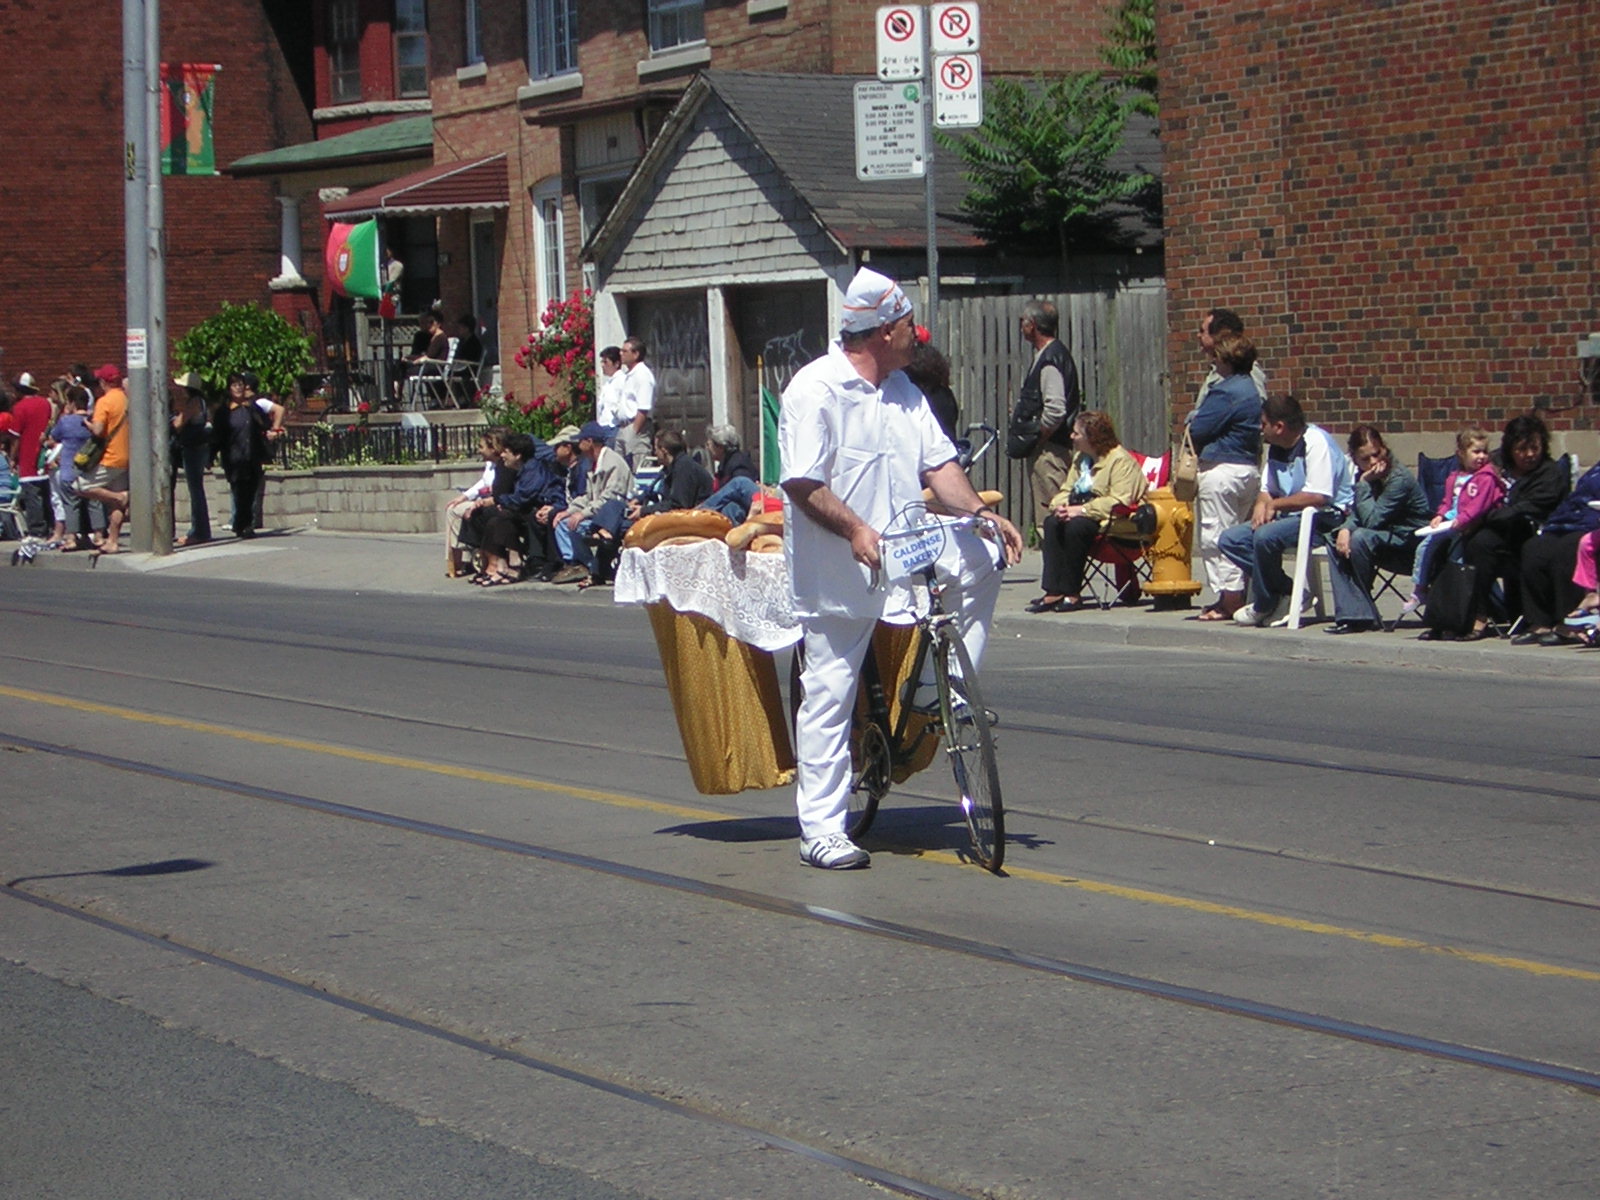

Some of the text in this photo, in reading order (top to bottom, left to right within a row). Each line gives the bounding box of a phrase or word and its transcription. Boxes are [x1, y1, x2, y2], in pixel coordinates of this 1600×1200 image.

[1467, 482, 1478, 497] G
[893, 534, 942, 559] CALDENSE
[902, 547, 939, 568] BAKERY
